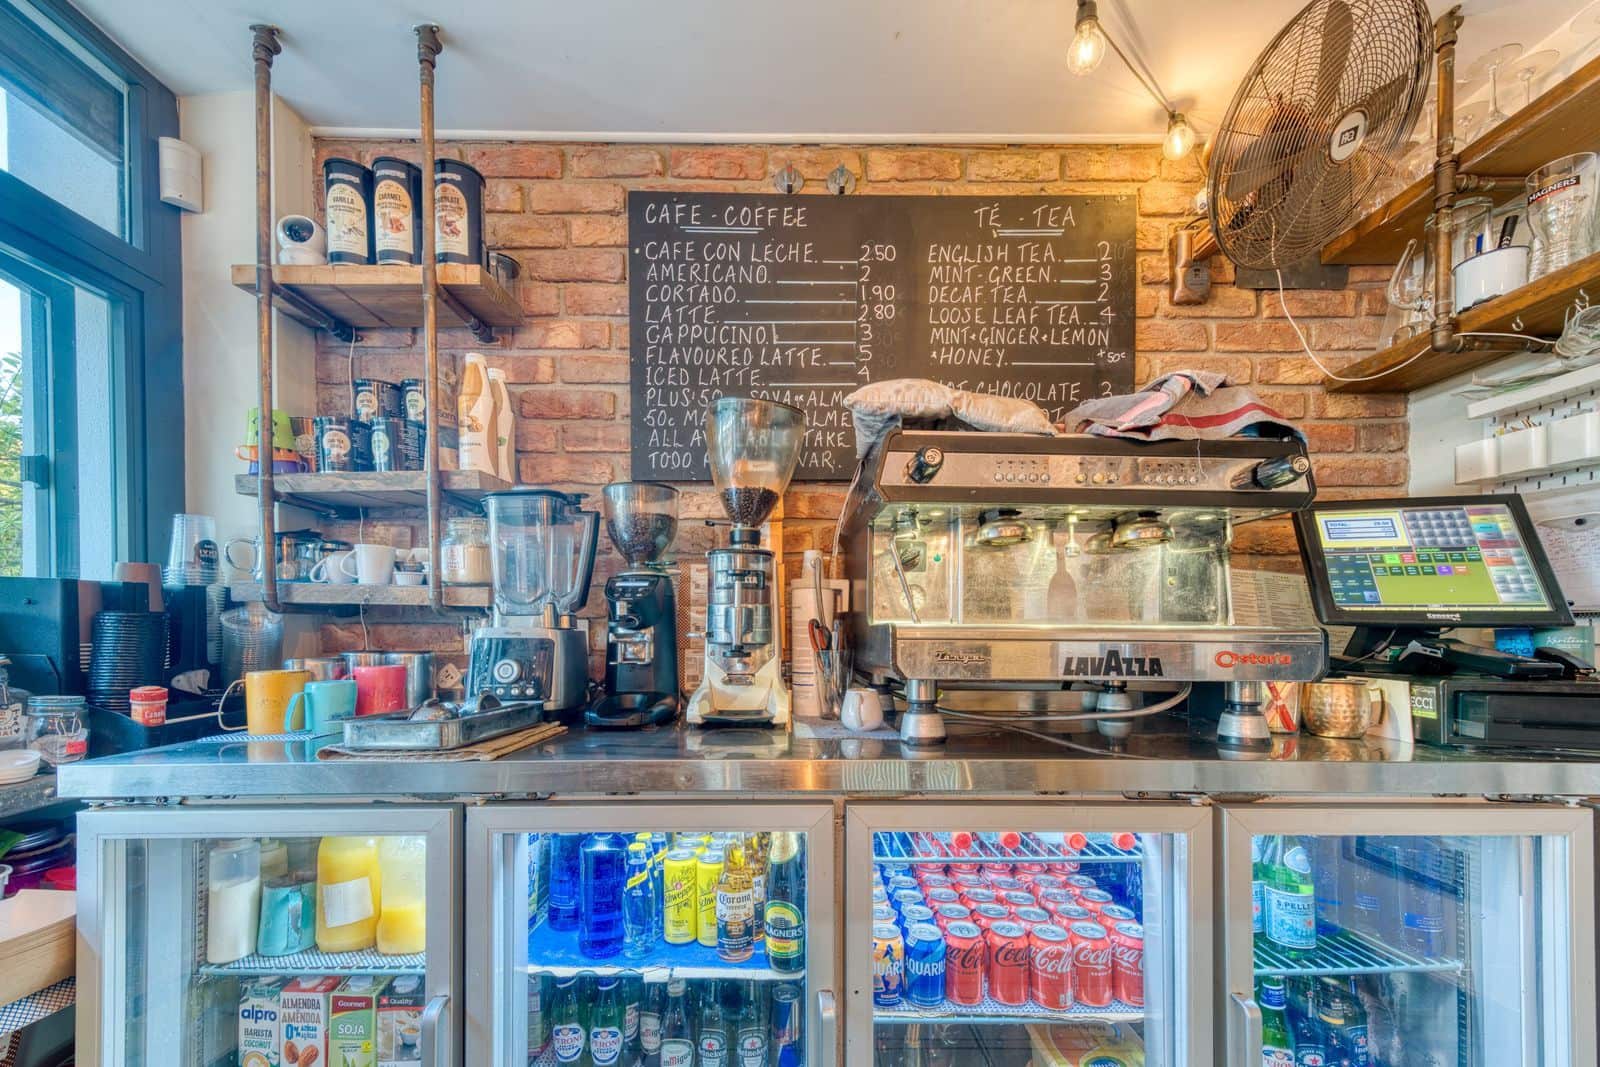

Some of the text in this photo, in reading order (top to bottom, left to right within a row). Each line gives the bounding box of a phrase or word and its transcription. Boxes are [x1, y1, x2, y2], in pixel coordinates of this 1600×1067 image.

[1529, 177, 1577, 202] MAGNERS
[646, 203, 808, 227] CAFE COFFEE
[974, 203, 1076, 227] TÉ TEA
[645, 241, 695, 262] CAFE
[703, 241, 740, 262] CON
[859, 244, 897, 262] 2.50
[928, 243, 1008, 265] ENGLISH
[1097, 241, 1113, 261] 2
[646, 263, 871, 284] AMERICANO. 2
[1100, 264, 1112, 281] 3
[860, 285, 896, 302] 1.90
[929, 285, 984, 304] DECAF
[1097, 284, 1110, 302] 2
[857, 304, 896, 321] 2.80
[929, 306, 987, 325] LOOSE
[993, 305, 1040, 325] LEAF
[1099, 306, 1117, 324] 4
[859, 323, 873, 342] 3
[645, 345, 752, 367] FLAVOURED
[858, 344, 873, 361] 5
[645, 366, 690, 387] ICED
[857, 366, 871, 383] 4
[976, 379, 1081, 402] CHOCOLATE
[649, 429, 686, 448] ALL
[803, 428, 851, 448] TAKE
[1063, 650, 1164, 677] LAVAZZA
[719, 893, 752, 906] Corona
[281, 997, 321, 1010] ALMENDRA
[337, 999, 367, 1008] Gourmet
[390, 998, 414, 1006] Quality
[241, 1004, 278, 1025] alpro
[243, 1027, 273, 1038] BARISTA
[338, 1024, 365, 1035] SOJA
[243, 1040, 271, 1049] COCONUT
